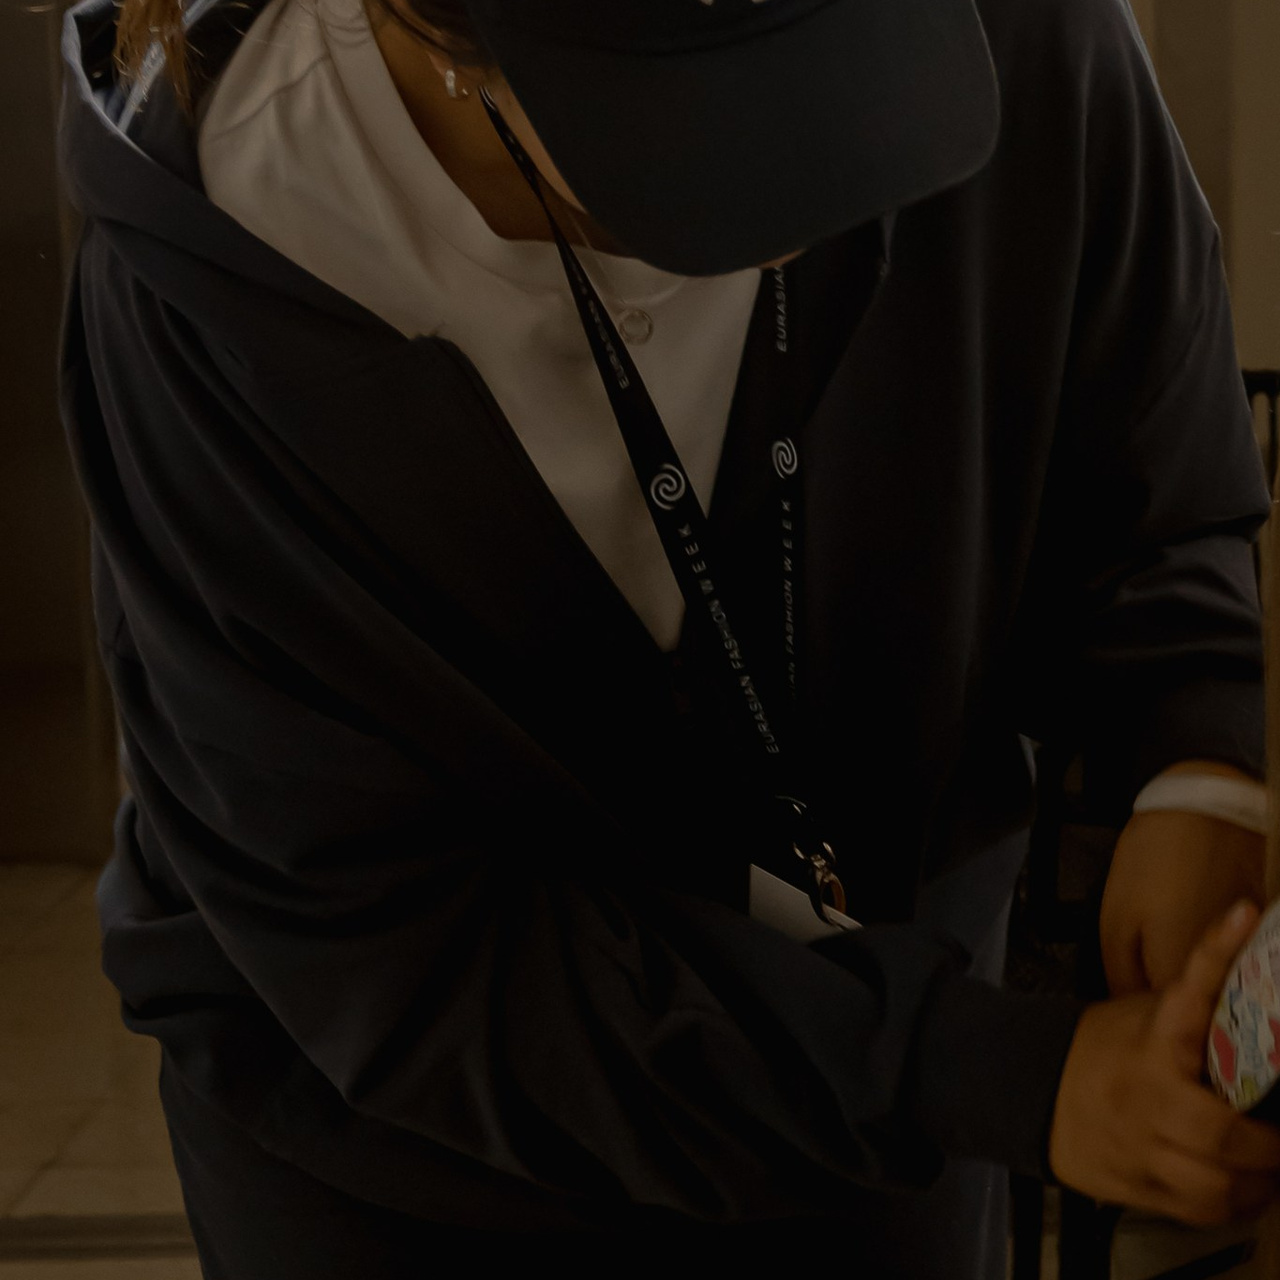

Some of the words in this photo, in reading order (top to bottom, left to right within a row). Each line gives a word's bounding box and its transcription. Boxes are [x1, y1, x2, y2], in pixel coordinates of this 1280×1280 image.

[677, 522, 715, 595] WEEK
[780, 497, 793, 572] WEEK
[738, 675, 780, 754] EURASIAN
